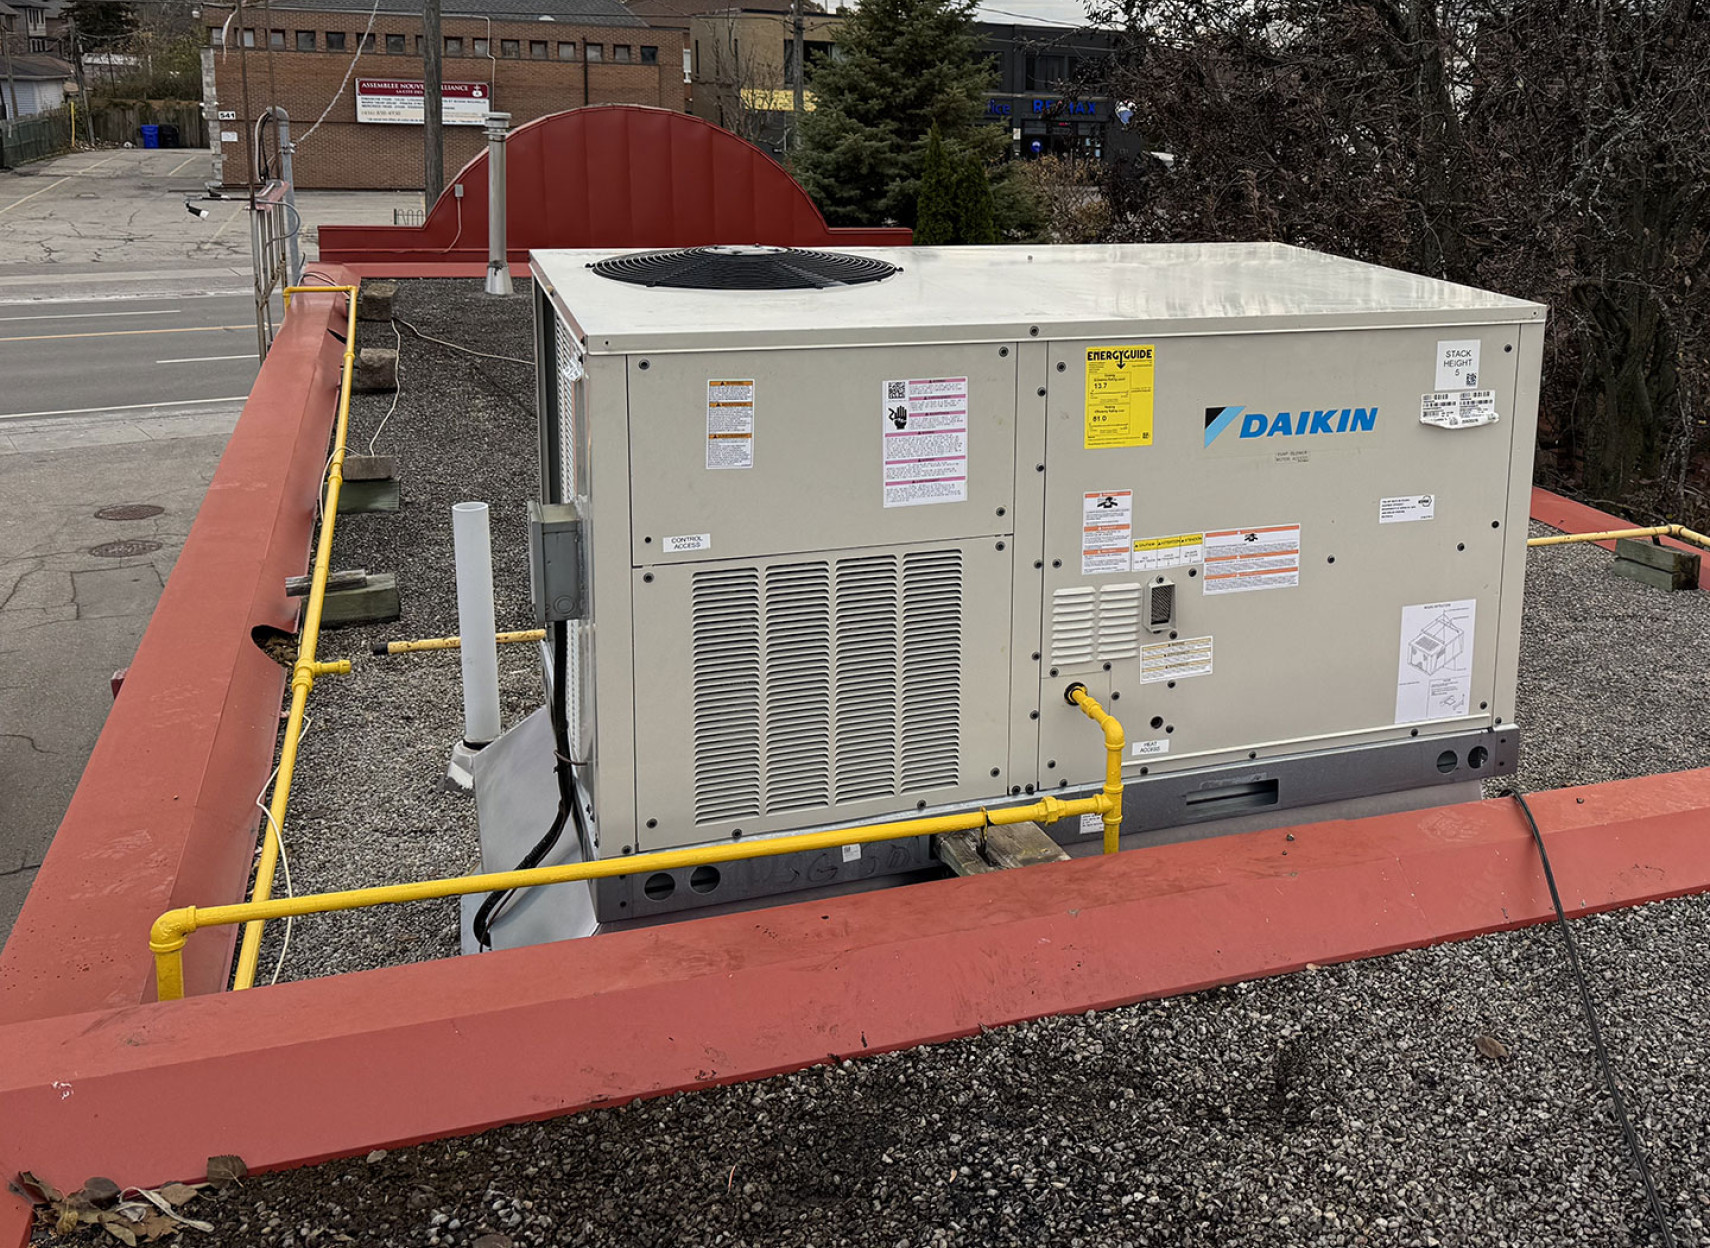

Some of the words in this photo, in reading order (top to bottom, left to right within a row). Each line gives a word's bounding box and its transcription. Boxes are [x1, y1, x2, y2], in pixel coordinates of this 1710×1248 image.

[1087, 349, 1153, 361] ENERGYGUIDE
[1445, 349, 1472, 358] STACK
[1443, 359, 1472, 368] HEIGHT
[1455, 368, 1460, 376] 5
[1239, 407, 1379, 439] DAIKIN
[671, 535, 704, 544] CONTROL
[674, 541, 701, 549] ACCESS
